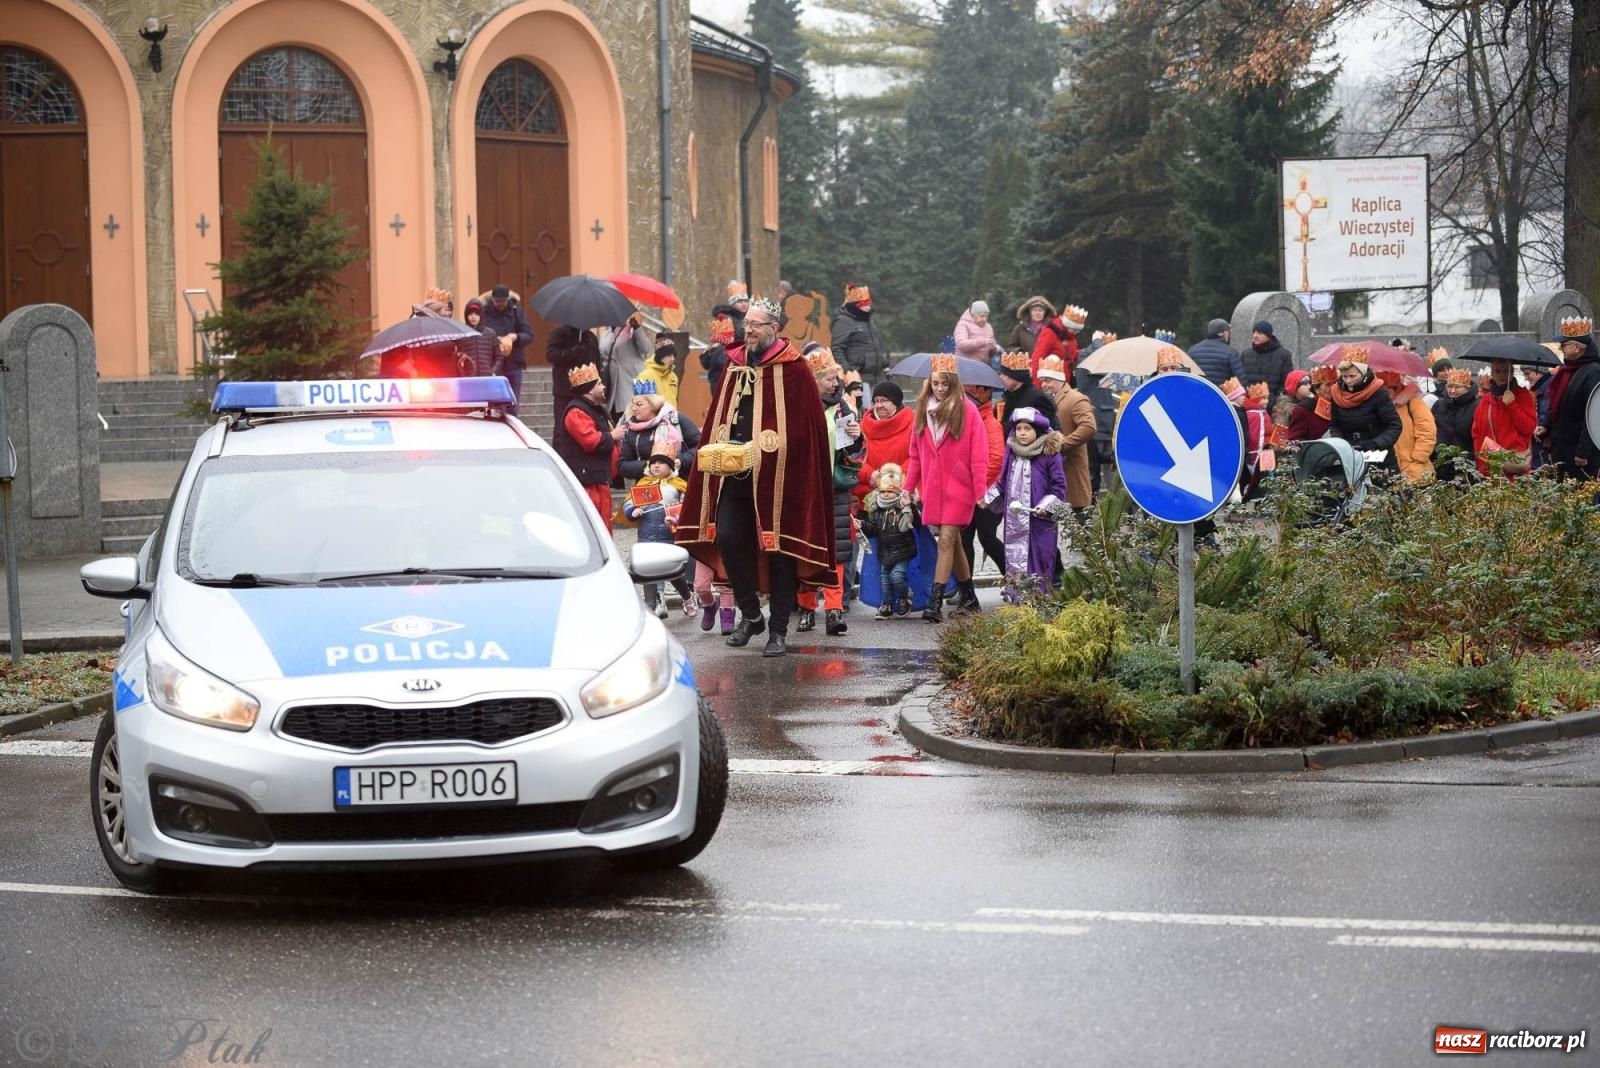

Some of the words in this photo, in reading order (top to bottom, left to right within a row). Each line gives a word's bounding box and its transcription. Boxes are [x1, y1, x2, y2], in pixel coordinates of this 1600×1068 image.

[1352, 196, 1401, 216] Kaplica
[1339, 217, 1414, 238] Wieczystej
[1349, 239, 1405, 259] Adoracji
[309, 383, 403, 405] POLICJA
[325, 640, 510, 667] POLICJA
[404, 679, 439, 691] KIA
[358, 770, 417, 801] HPP
[431, 767, 507, 799] R006
[338, 790, 350, 799] PL
